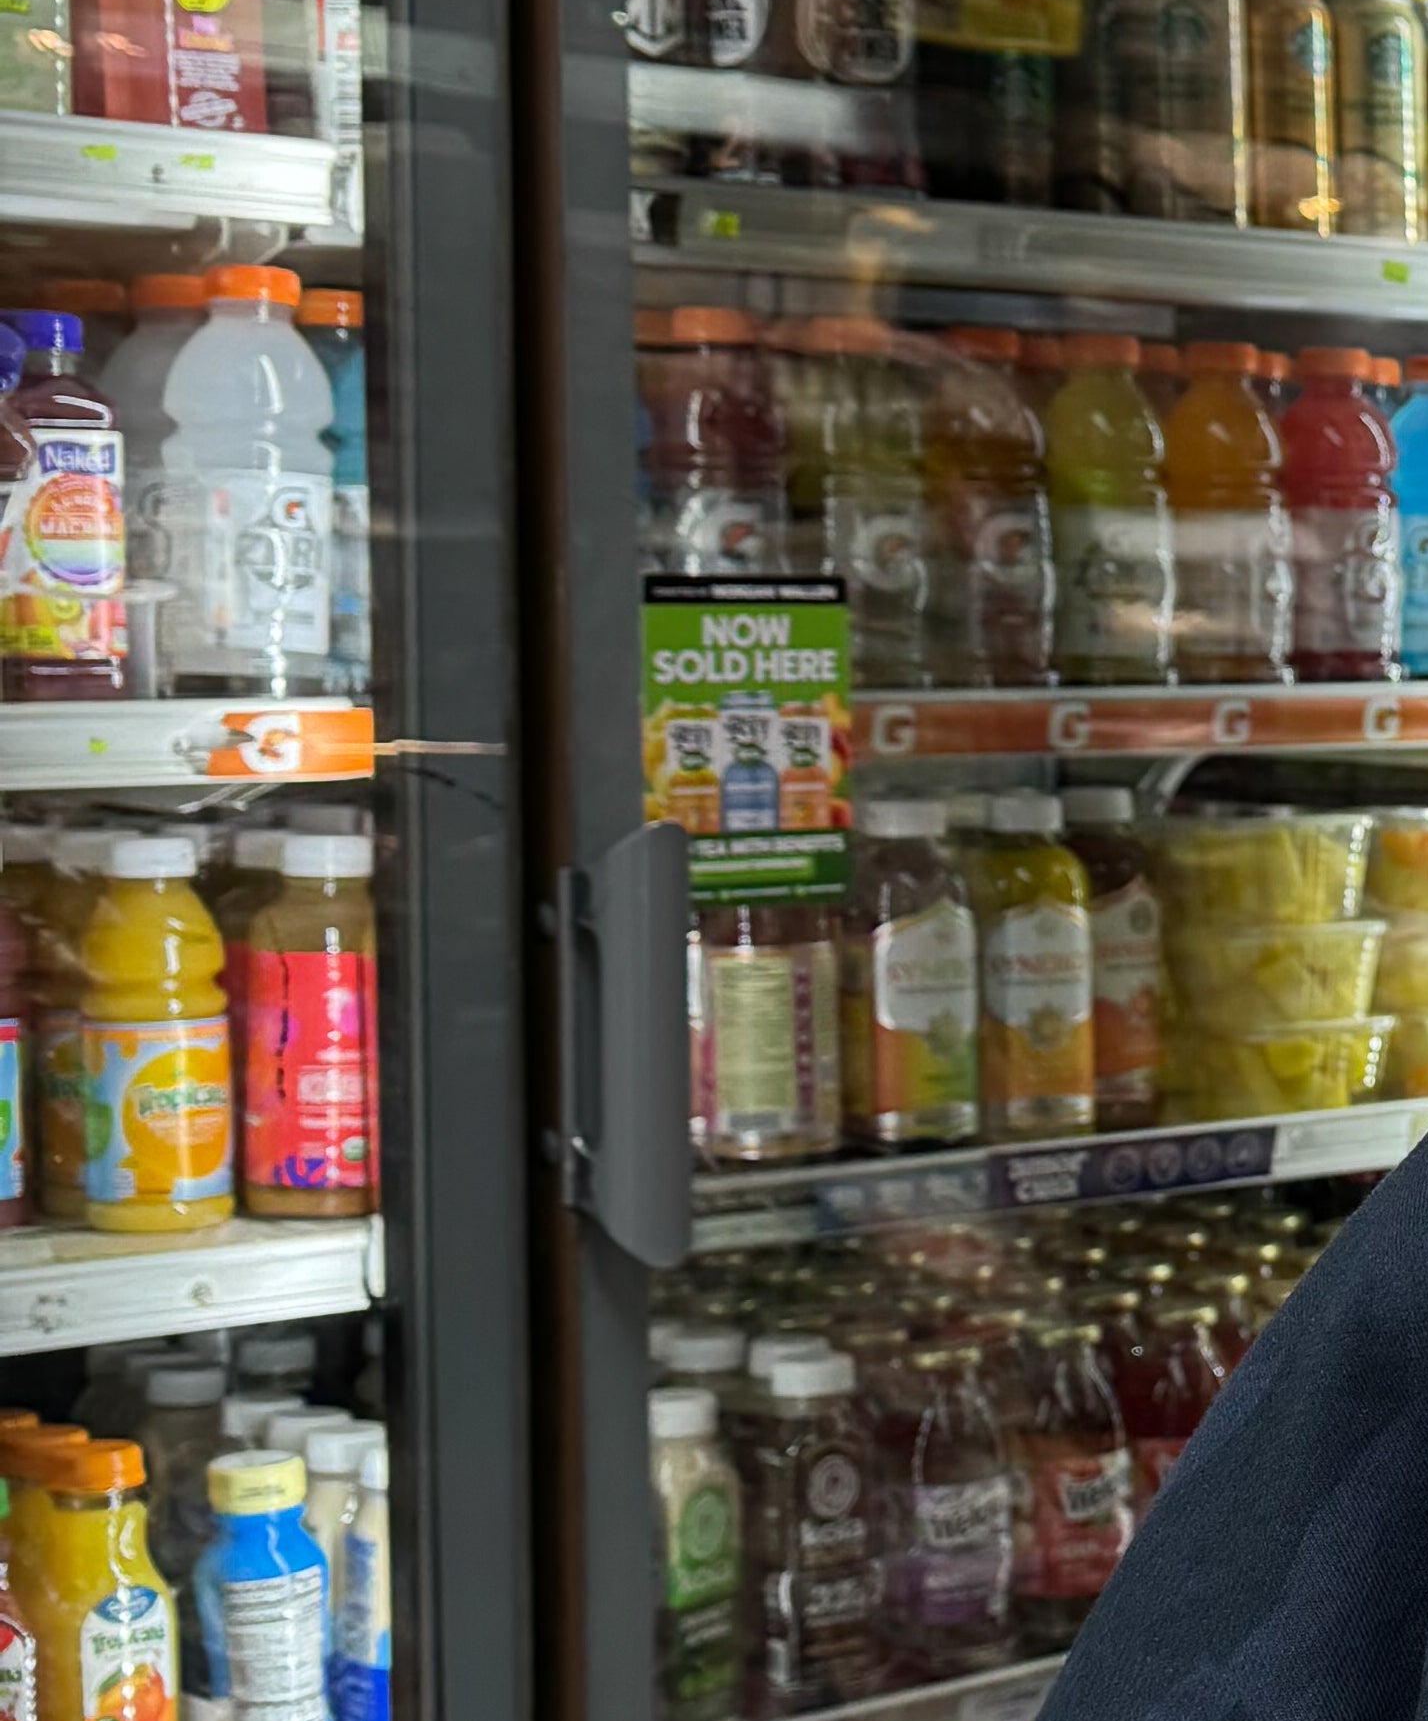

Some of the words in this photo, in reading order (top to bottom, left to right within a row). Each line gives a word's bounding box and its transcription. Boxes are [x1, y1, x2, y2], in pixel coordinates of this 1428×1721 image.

[700, 613, 791, 648] NOW
[652, 649, 748, 684] SOLD
[754, 648, 839, 681] HERE
[870, 704, 916, 754] G
[1047, 701, 1091, 749] G
[1212, 699, 1252, 744] G
